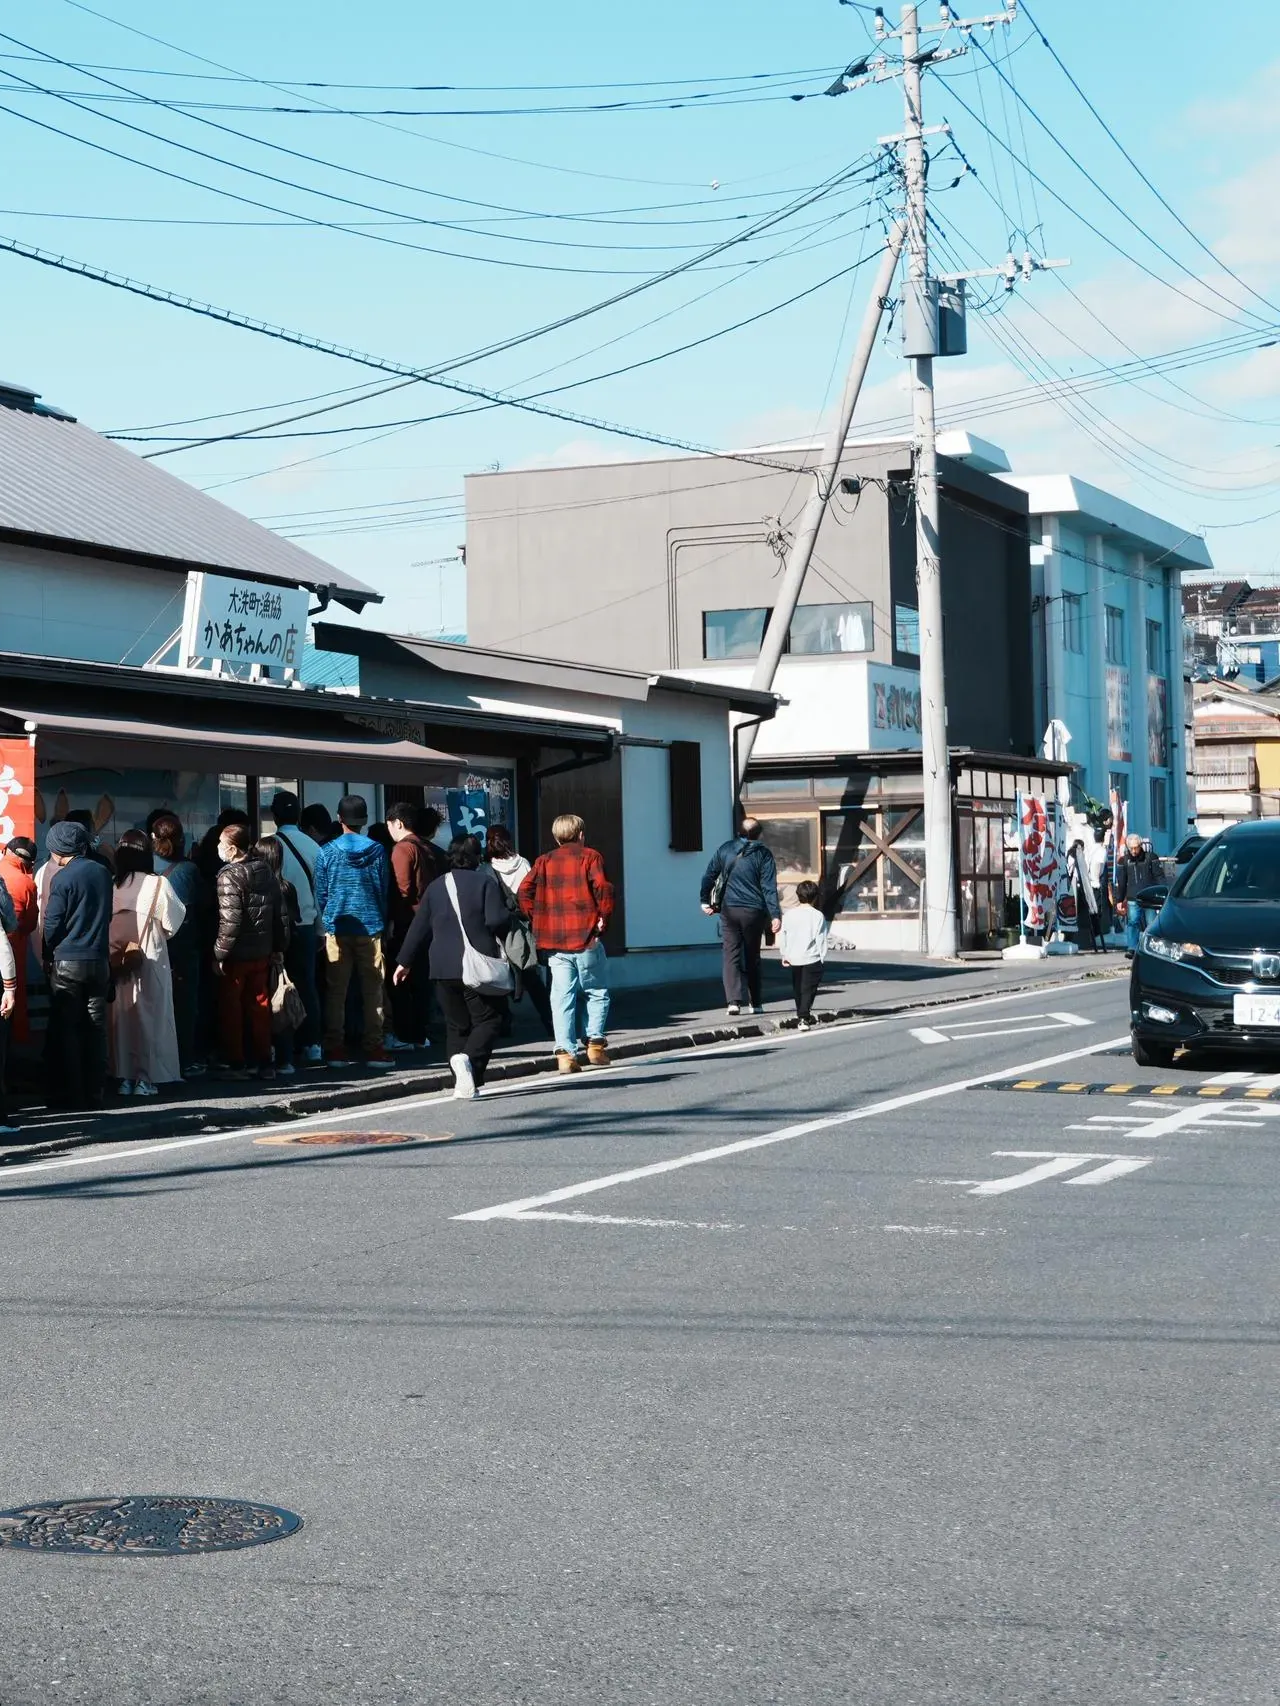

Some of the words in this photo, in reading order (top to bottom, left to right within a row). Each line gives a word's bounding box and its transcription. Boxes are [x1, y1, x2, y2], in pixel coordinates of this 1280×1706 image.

[228, 587, 282, 620] 大洗町漁協
[204, 618, 298, 664] かあちゃんの店
[457, 805, 488, 849] お
